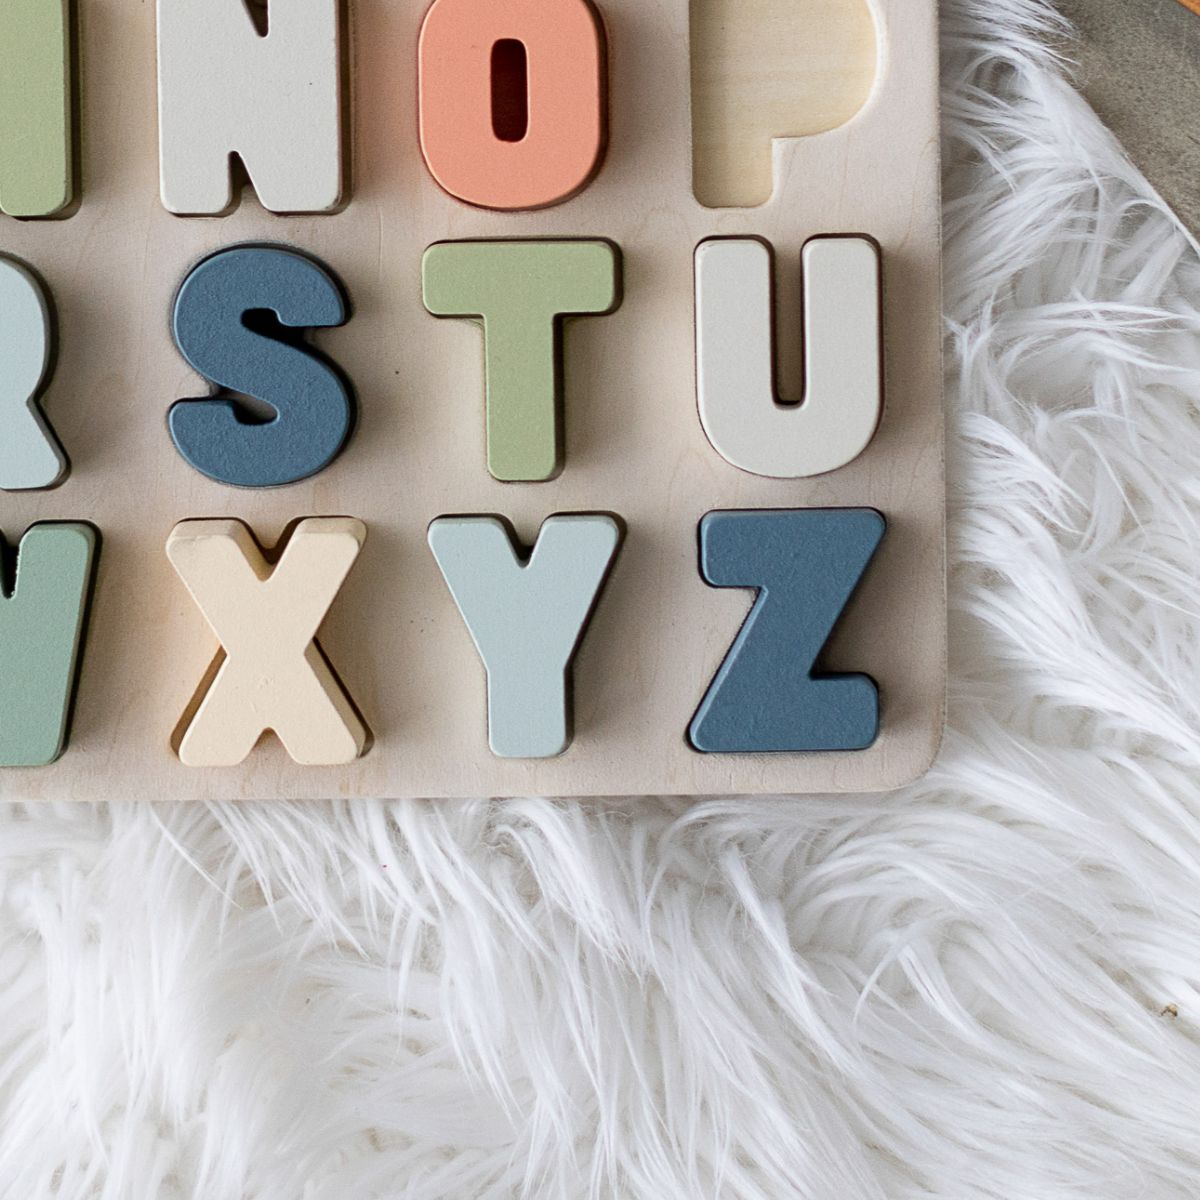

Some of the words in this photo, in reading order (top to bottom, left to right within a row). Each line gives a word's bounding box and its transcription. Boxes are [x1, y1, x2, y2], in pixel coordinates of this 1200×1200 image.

[168, 245, 354, 488] S
[422, 239, 621, 482] T
[693, 235, 883, 479] U
[166, 517, 370, 767] X
[426, 512, 621, 759] Y
[687, 508, 886, 754] Z
